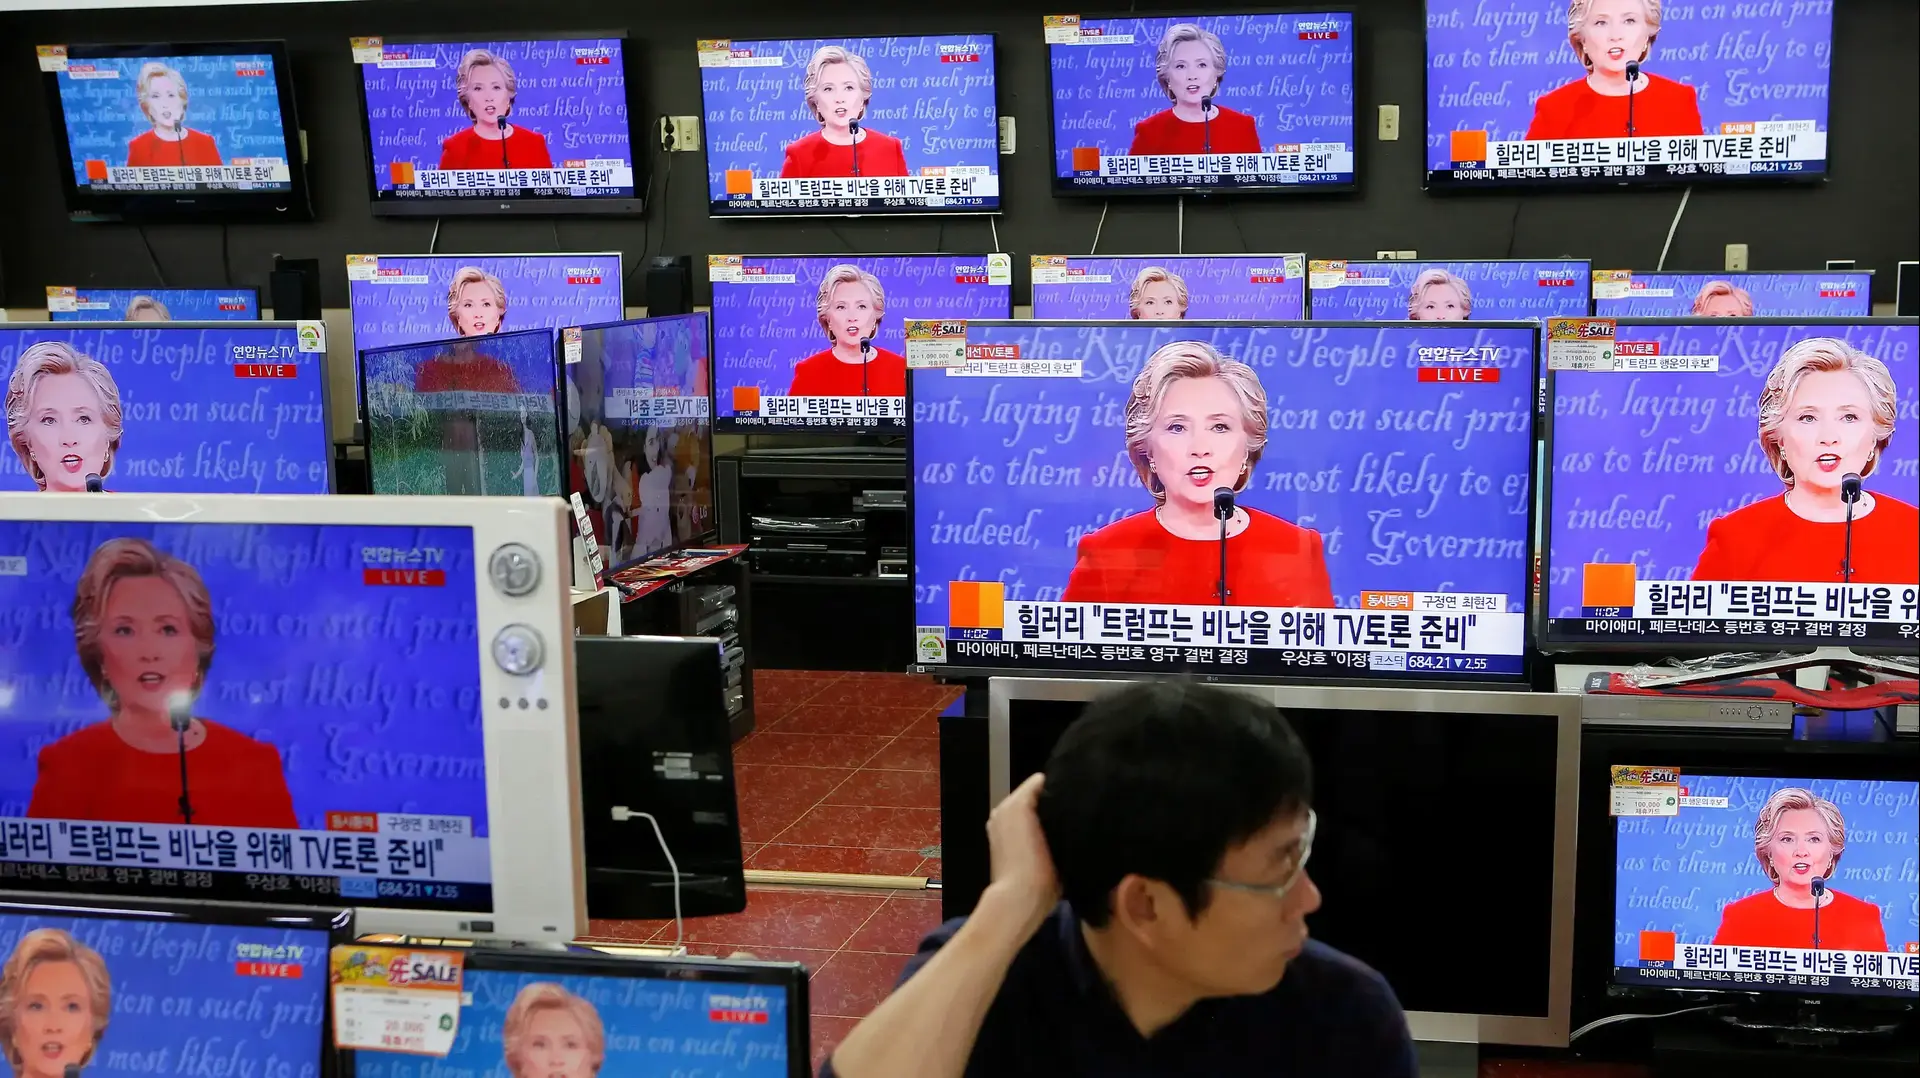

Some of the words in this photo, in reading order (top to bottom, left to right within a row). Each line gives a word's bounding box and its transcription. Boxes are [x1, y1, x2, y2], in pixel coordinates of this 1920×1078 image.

[1298, 22, 1338, 30] 연합뉴스TV
[940, 44, 979, 52] 연합뉴스TV
[1495, 142, 1539, 167] 힐러리
[1545, 139, 1611, 165] "트럼프는
[1616, 139, 1662, 163] 비난을
[1667, 137, 1698, 162] 위해
[1702, 137, 1754, 161] TV토론
[1758, 134, 1796, 159] 준비"
[1107, 157, 1140, 175] 힐러리
[1144, 155, 1194, 174] "트럼프는
[1198, 155, 1232, 174] 비난을
[1235, 154, 1258, 173] 위해
[1262, 155, 1300, 172] TV토론
[1303, 153, 1332, 172] 준비"
[420, 171, 449, 188] 힐러리
[452, 170, 496, 188] "트럼프는
[498, 170, 528, 187] 비난을
[531, 170, 551, 187] 위해
[553, 170, 587, 186] TV토론
[589, 168, 614, 186] 준비"
[759, 180, 791, 198] 힐러리
[795, 178, 843, 198] "트럼프는
[847, 178, 880, 197] 비난을
[883, 178, 906, 197] 위해
[909, 178, 946, 196] TV토론
[949, 176, 977, 195] 준비"
[955, 266, 988, 274] 연합뉴스T
[233, 346, 295, 359] 연합뉴스TV
[983, 347, 1014, 358] TV토론
[1020, 328, 1062, 360] the
[1226, 328, 1277, 368] the
[1289, 328, 1396, 386] People
[1418, 347, 1501, 362] 연합뉴스TV
[1624, 345, 1654, 355] TV토론
[249, 365, 284, 377] LIVE
[984, 362, 1019, 374] "트럼프
[1021, 363, 1050, 375] 행운의
[1052, 363, 1077, 375] 후보"
[1624, 358, 1658, 370] "트럼프
[1660, 359, 1688, 370] 행운의
[1690, 359, 1714, 370] 후보"
[1437, 368, 1483, 381] LIVE
[207, 386, 268, 423] such
[766, 397, 798, 416] 힐러리
[803, 397, 852, 416] "트럼프는
[856, 398, 889, 416] 비난을
[1328, 408, 1366, 431] on
[1376, 390, 1464, 432] such
[1619, 378, 1717, 437] laying
[981, 384, 1081, 447] laying
[1642, 434, 1713, 474] them
[127, 448, 185, 478] most
[193, 441, 263, 490] likely
[922, 461, 957, 484] as
[966, 456, 995, 485] to
[1007, 445, 1080, 487] them
[1265, 463, 1343, 492] most
[1350, 452, 1449, 518] likely
[1460, 466, 1490, 495] to
[930, 507, 1042, 550] indeed,
[361, 547, 444, 564] 연합뉴스TV
[381, 570, 429, 585] LIVE
[1366, 594, 1410, 608] 동시통역
[1421, 595, 1457, 609] 구정연
[1461, 596, 1497, 611] 최현진
[1649, 583, 1712, 618] 힐러리
[1718, 582, 1817, 618] "트럼프는
[1824, 586, 1892, 620] 비난을
[1595, 608, 1619, 618] 11:02
[963, 629, 989, 639] 11:02
[1018, 604, 1084, 640] 힐러리
[1093, 605, 1194, 642] "트럼프는
[1202, 609, 1271, 645] 비난을
[1279, 610, 1326, 647] 위해
[1333, 614, 1412, 648] TV토론
[1419, 613, 1477, 650] 준비"
[1585, 618, 1644, 634] 마이애미,
[1648, 619, 1721, 635] 페르난데스
[1724, 620, 1769, 635] 등번호
[1772, 620, 1802, 636] 영구
[1805, 622, 1834, 637] 결번
[1839, 623, 1869, 639] 결정
[957, 642, 1018, 659] 마이애미,
[1022, 643, 1097, 660] 페르난데스
[1100, 645, 1146, 661] 등번호
[1149, 645, 1180, 662] 영구
[1183, 647, 1213, 663] 결번
[1218, 648, 1248, 665] 결정
[1281, 651, 1328, 667] 우상호
[1373, 655, 1404, 668] 코스닥
[59, 822, 162, 863] "트럼프는
[168, 828, 239, 867] 비난을
[245, 830, 294, 871] 위해
[299, 836, 380, 873] TV토론
[386, 836, 445, 876] 준비"
[250, 964, 289, 977] LIVE
[1684, 946, 1727, 969] 힐러리
[1732, 948, 1798, 971] "트럼프는
[1803, 951, 1847, 974] 비난을
[1853, 953, 1883, 976] 위해
